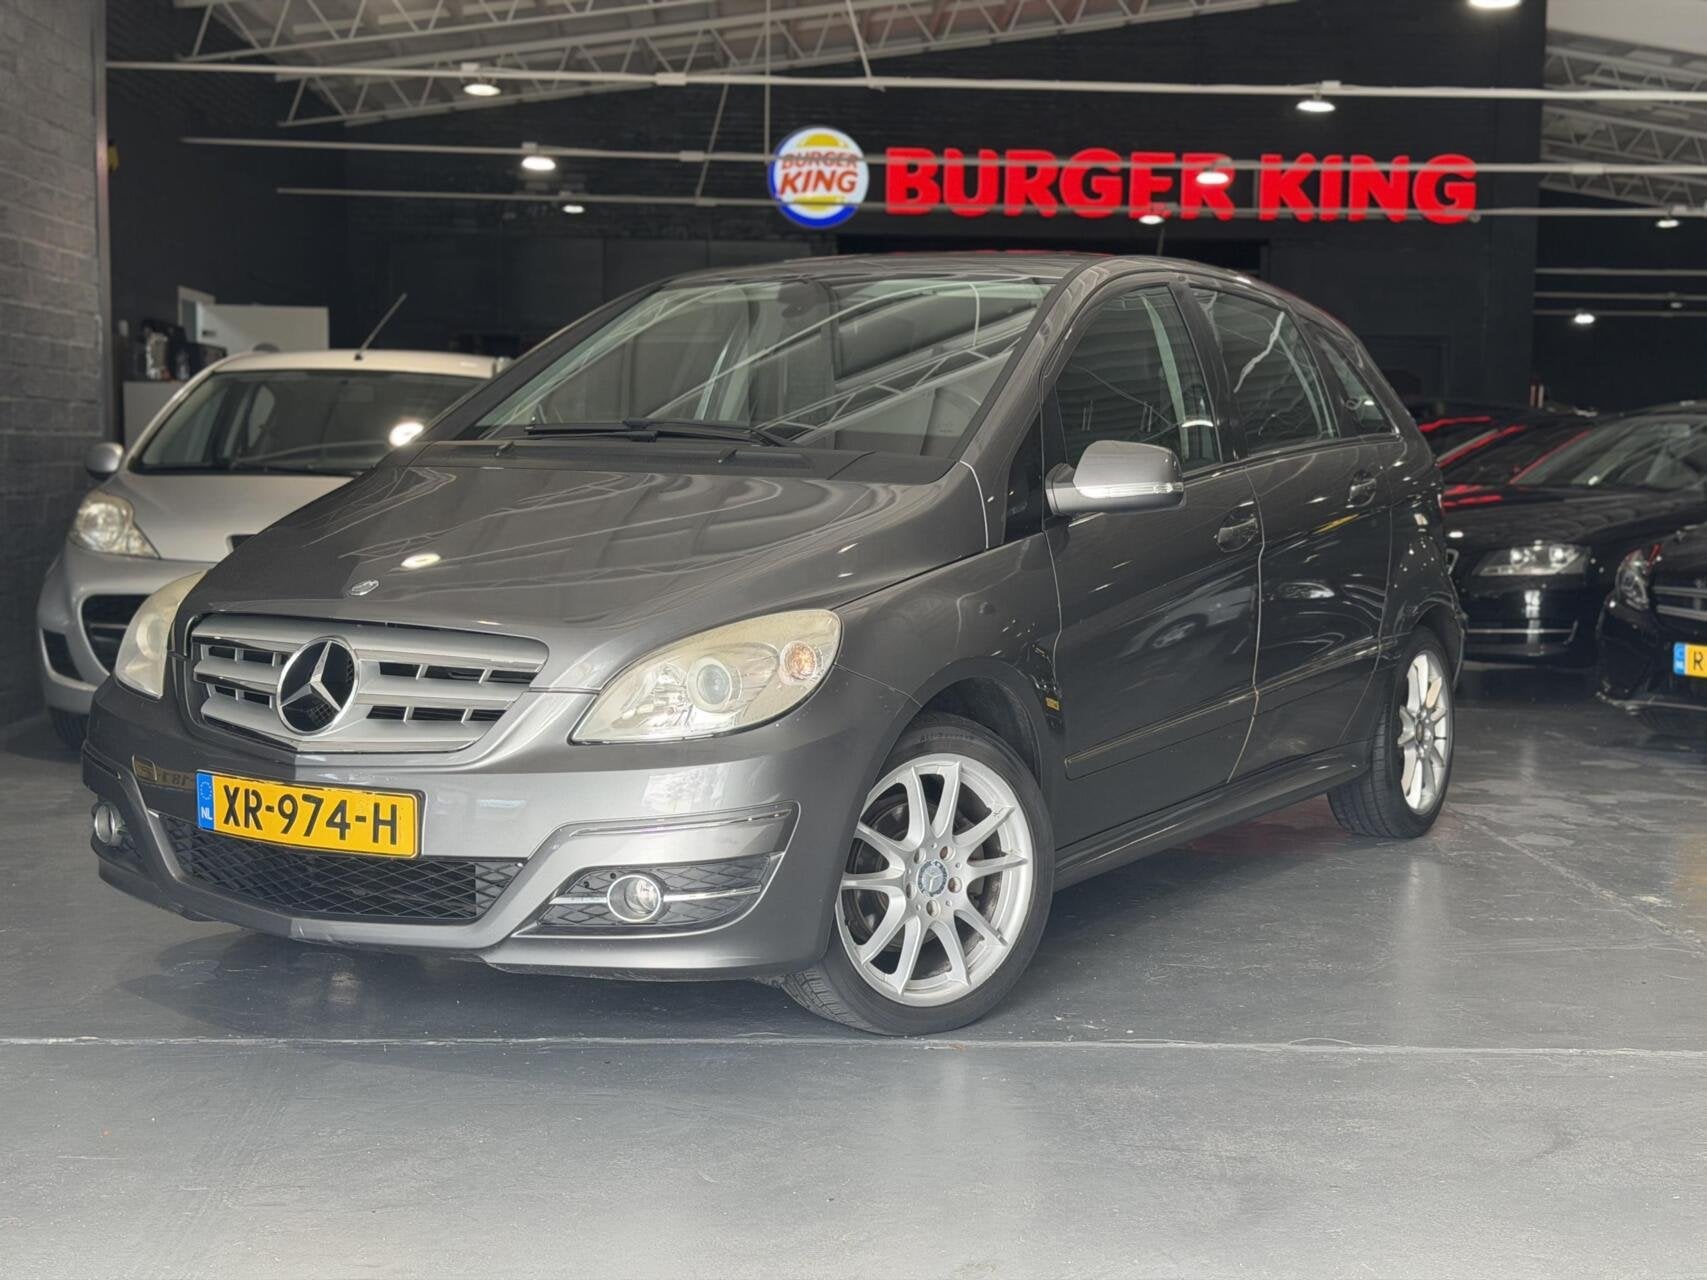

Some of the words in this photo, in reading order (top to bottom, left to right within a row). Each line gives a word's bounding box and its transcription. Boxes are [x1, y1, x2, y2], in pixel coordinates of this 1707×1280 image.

[779, 169, 859, 196] KING
[782, 151, 860, 170] BURGER
[885, 147, 1235, 221] BURGER
[1258, 152, 1477, 224] KING
[200, 806, 213, 820] NL
[223, 784, 398, 845] XR-974-H
